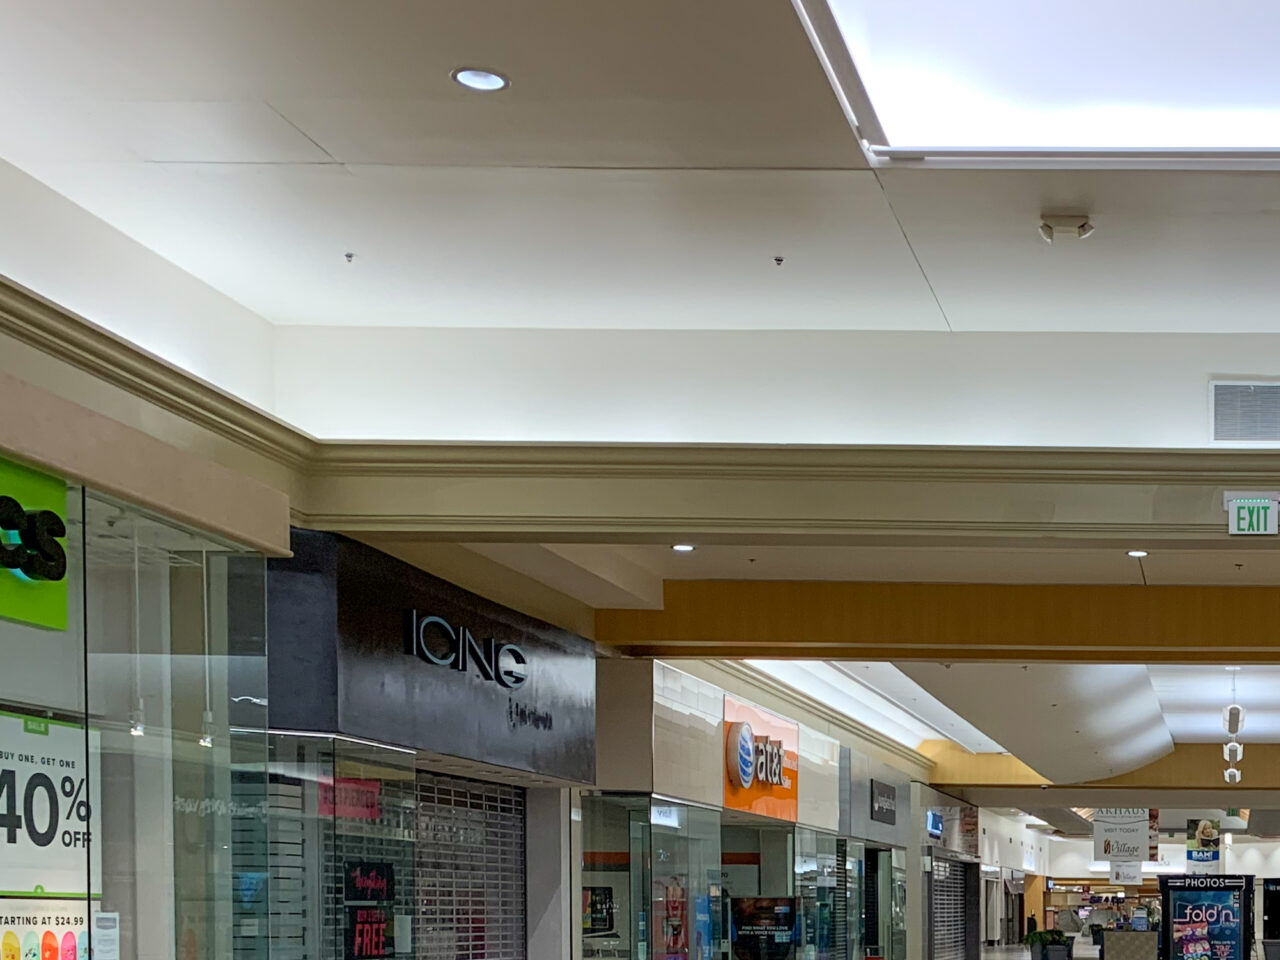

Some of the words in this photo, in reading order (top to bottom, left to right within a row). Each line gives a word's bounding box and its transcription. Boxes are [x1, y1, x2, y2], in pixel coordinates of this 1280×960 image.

[1237, 505, 1270, 532] EXIT
[403, 609, 528, 689] ICING
[0, 750, 15, 760] BUY
[18, 753, 38, 765] ONE,
[40, 756, 56, 767] GET
[59, 759, 76, 769] ONE
[757, 735, 785, 785] at&t
[61, 829, 92, 849] OFF
[1111, 841, 1140, 854] Village
[1185, 878, 1225, 888] PHOTOS
[41, 916, 52, 926] AT
[55, 916, 84, 926] $24.99
[1184, 905, 1234, 922] fold'n
[354, 923, 387, 957] FREE
